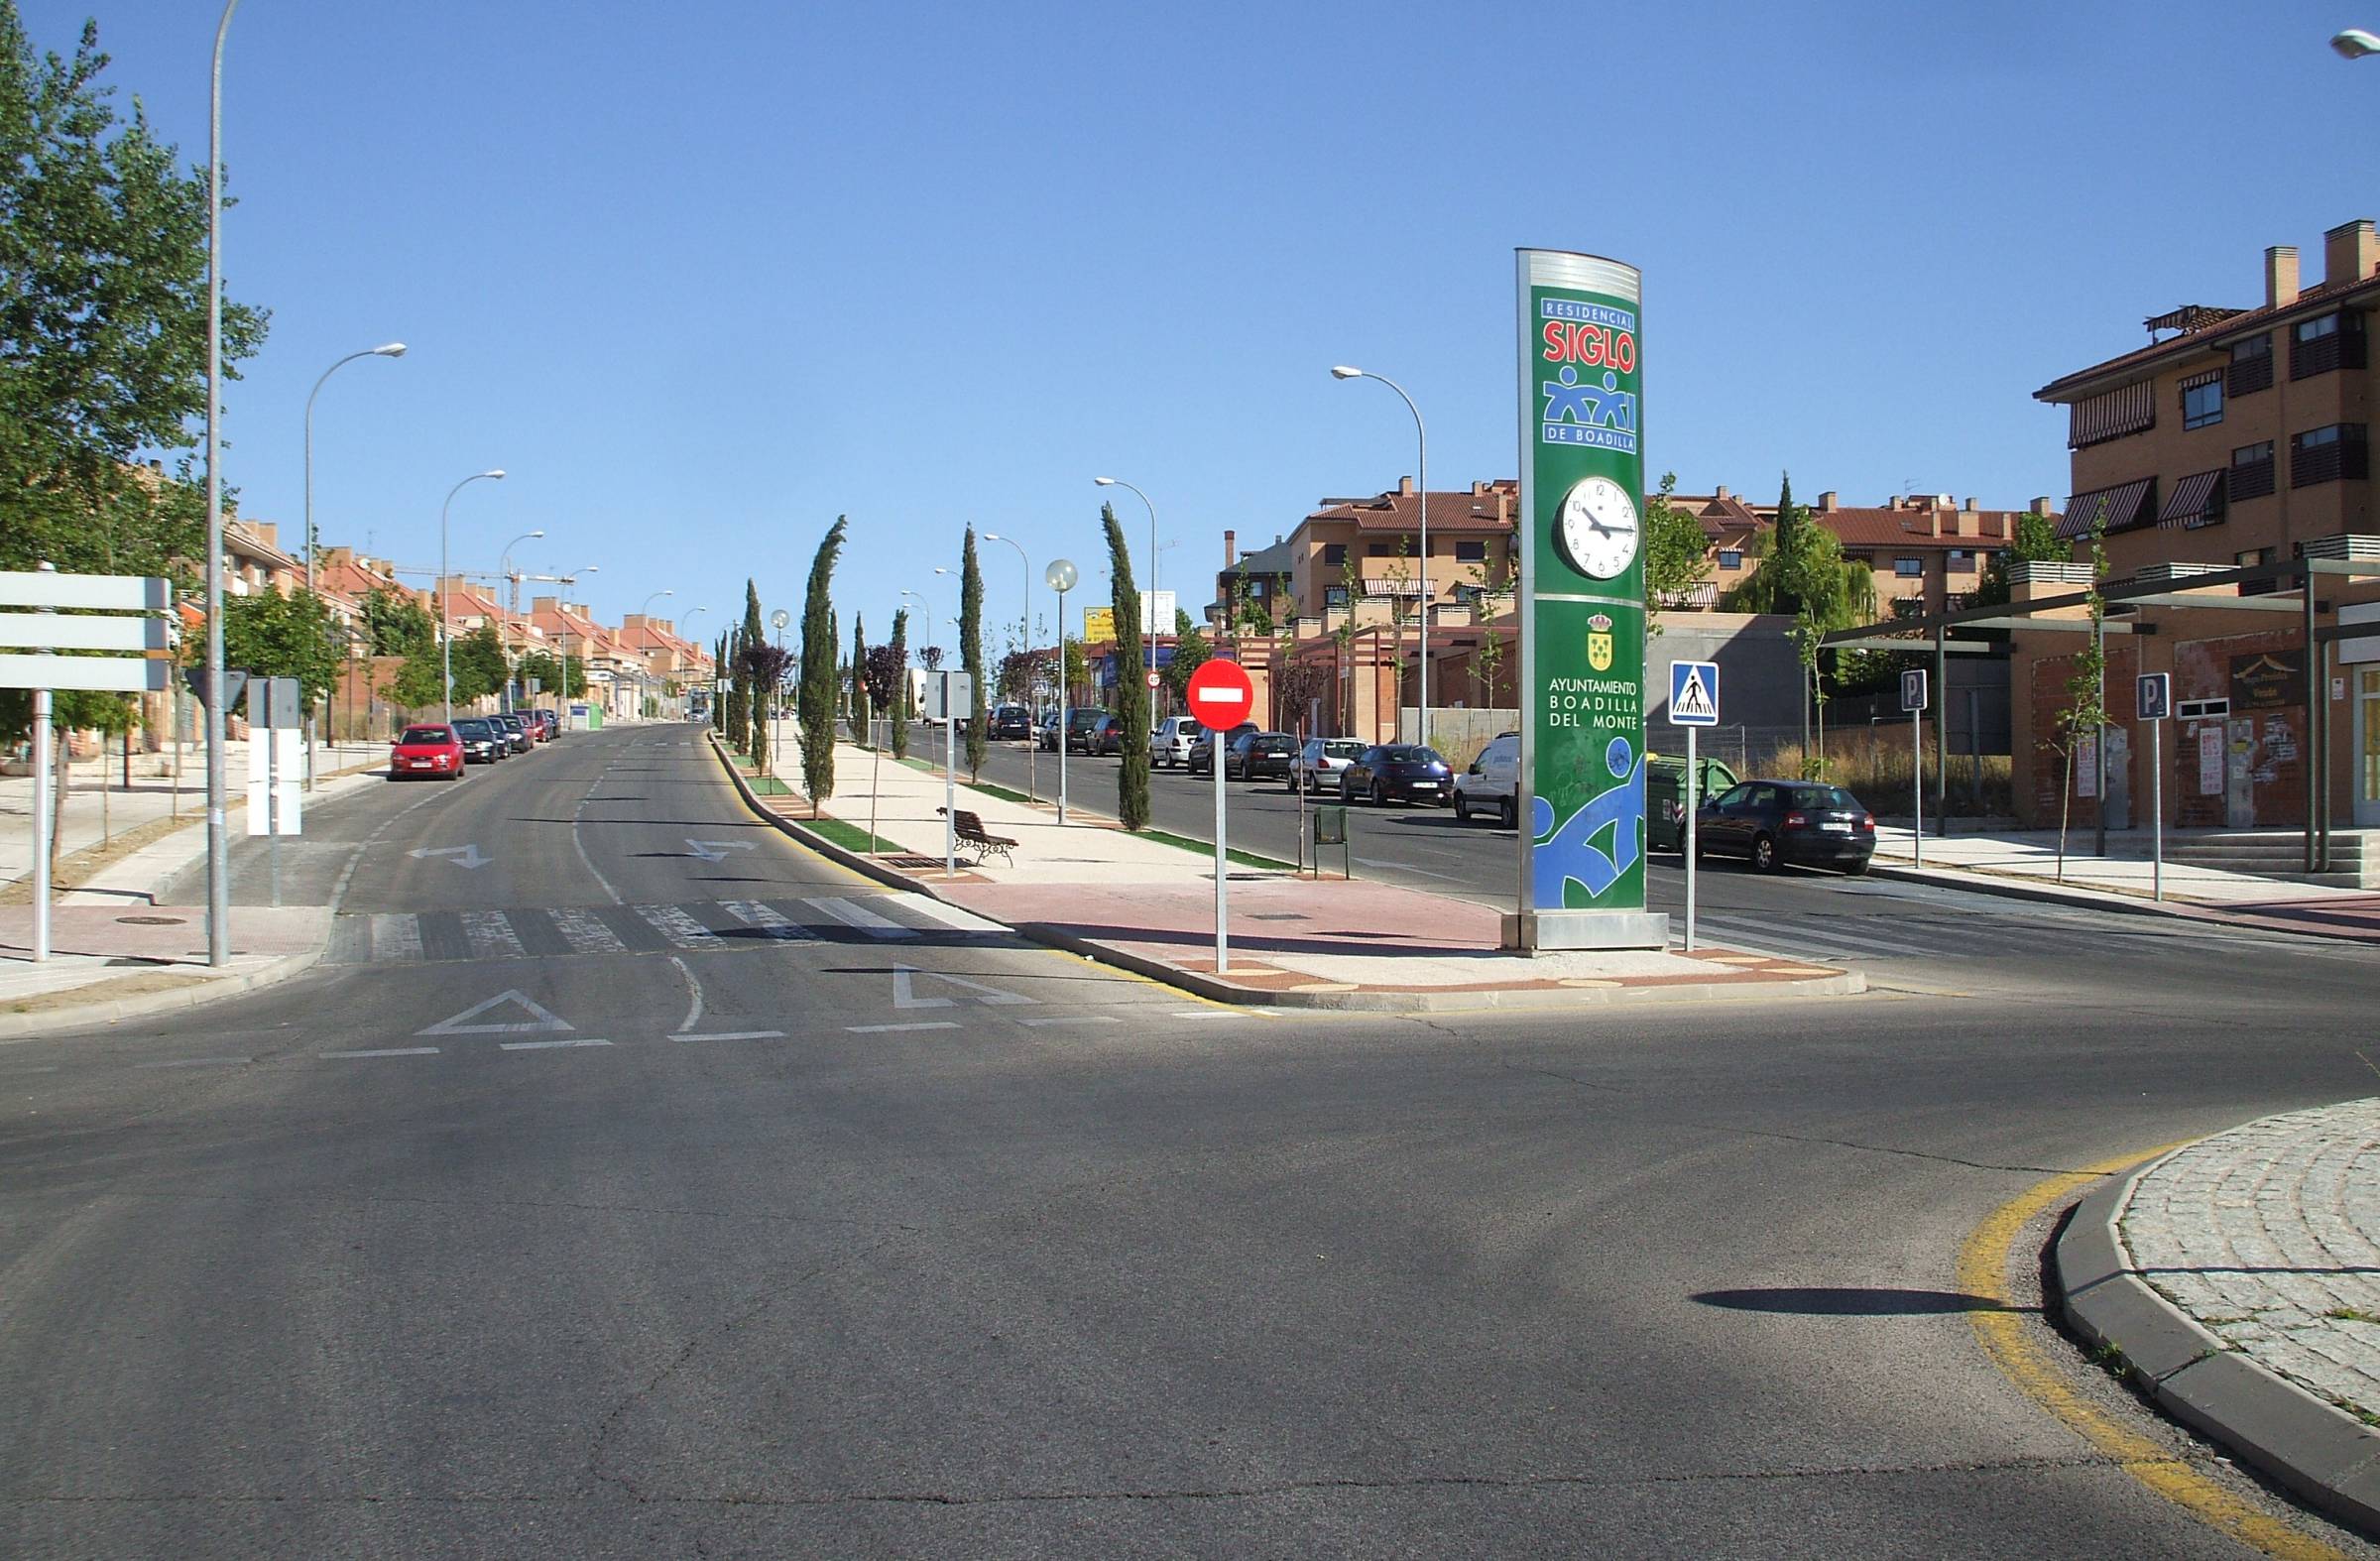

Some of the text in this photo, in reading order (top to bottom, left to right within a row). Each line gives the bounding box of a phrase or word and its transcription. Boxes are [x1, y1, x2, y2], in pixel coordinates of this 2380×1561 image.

[1546, 302, 1633, 330] RESIDENCIAL
[1543, 320, 1635, 374] SIGLO
[1548, 427, 1634, 450] DE BOADILLA
[1596, 484, 1605, 496] 12
[1622, 507, 1629, 518] 2
[1573, 539, 1580, 550] 8
[1584, 553, 1591, 564] 7
[1599, 560, 1605, 572] 6
[1549, 678, 1636, 695] AYUNTAMIENTO
[1907, 674, 1918, 705] P
[1550, 695, 1637, 713] BOADILLA
[2144, 678, 2158, 714] P
[1550, 713, 1637, 730] DEL MONTE
